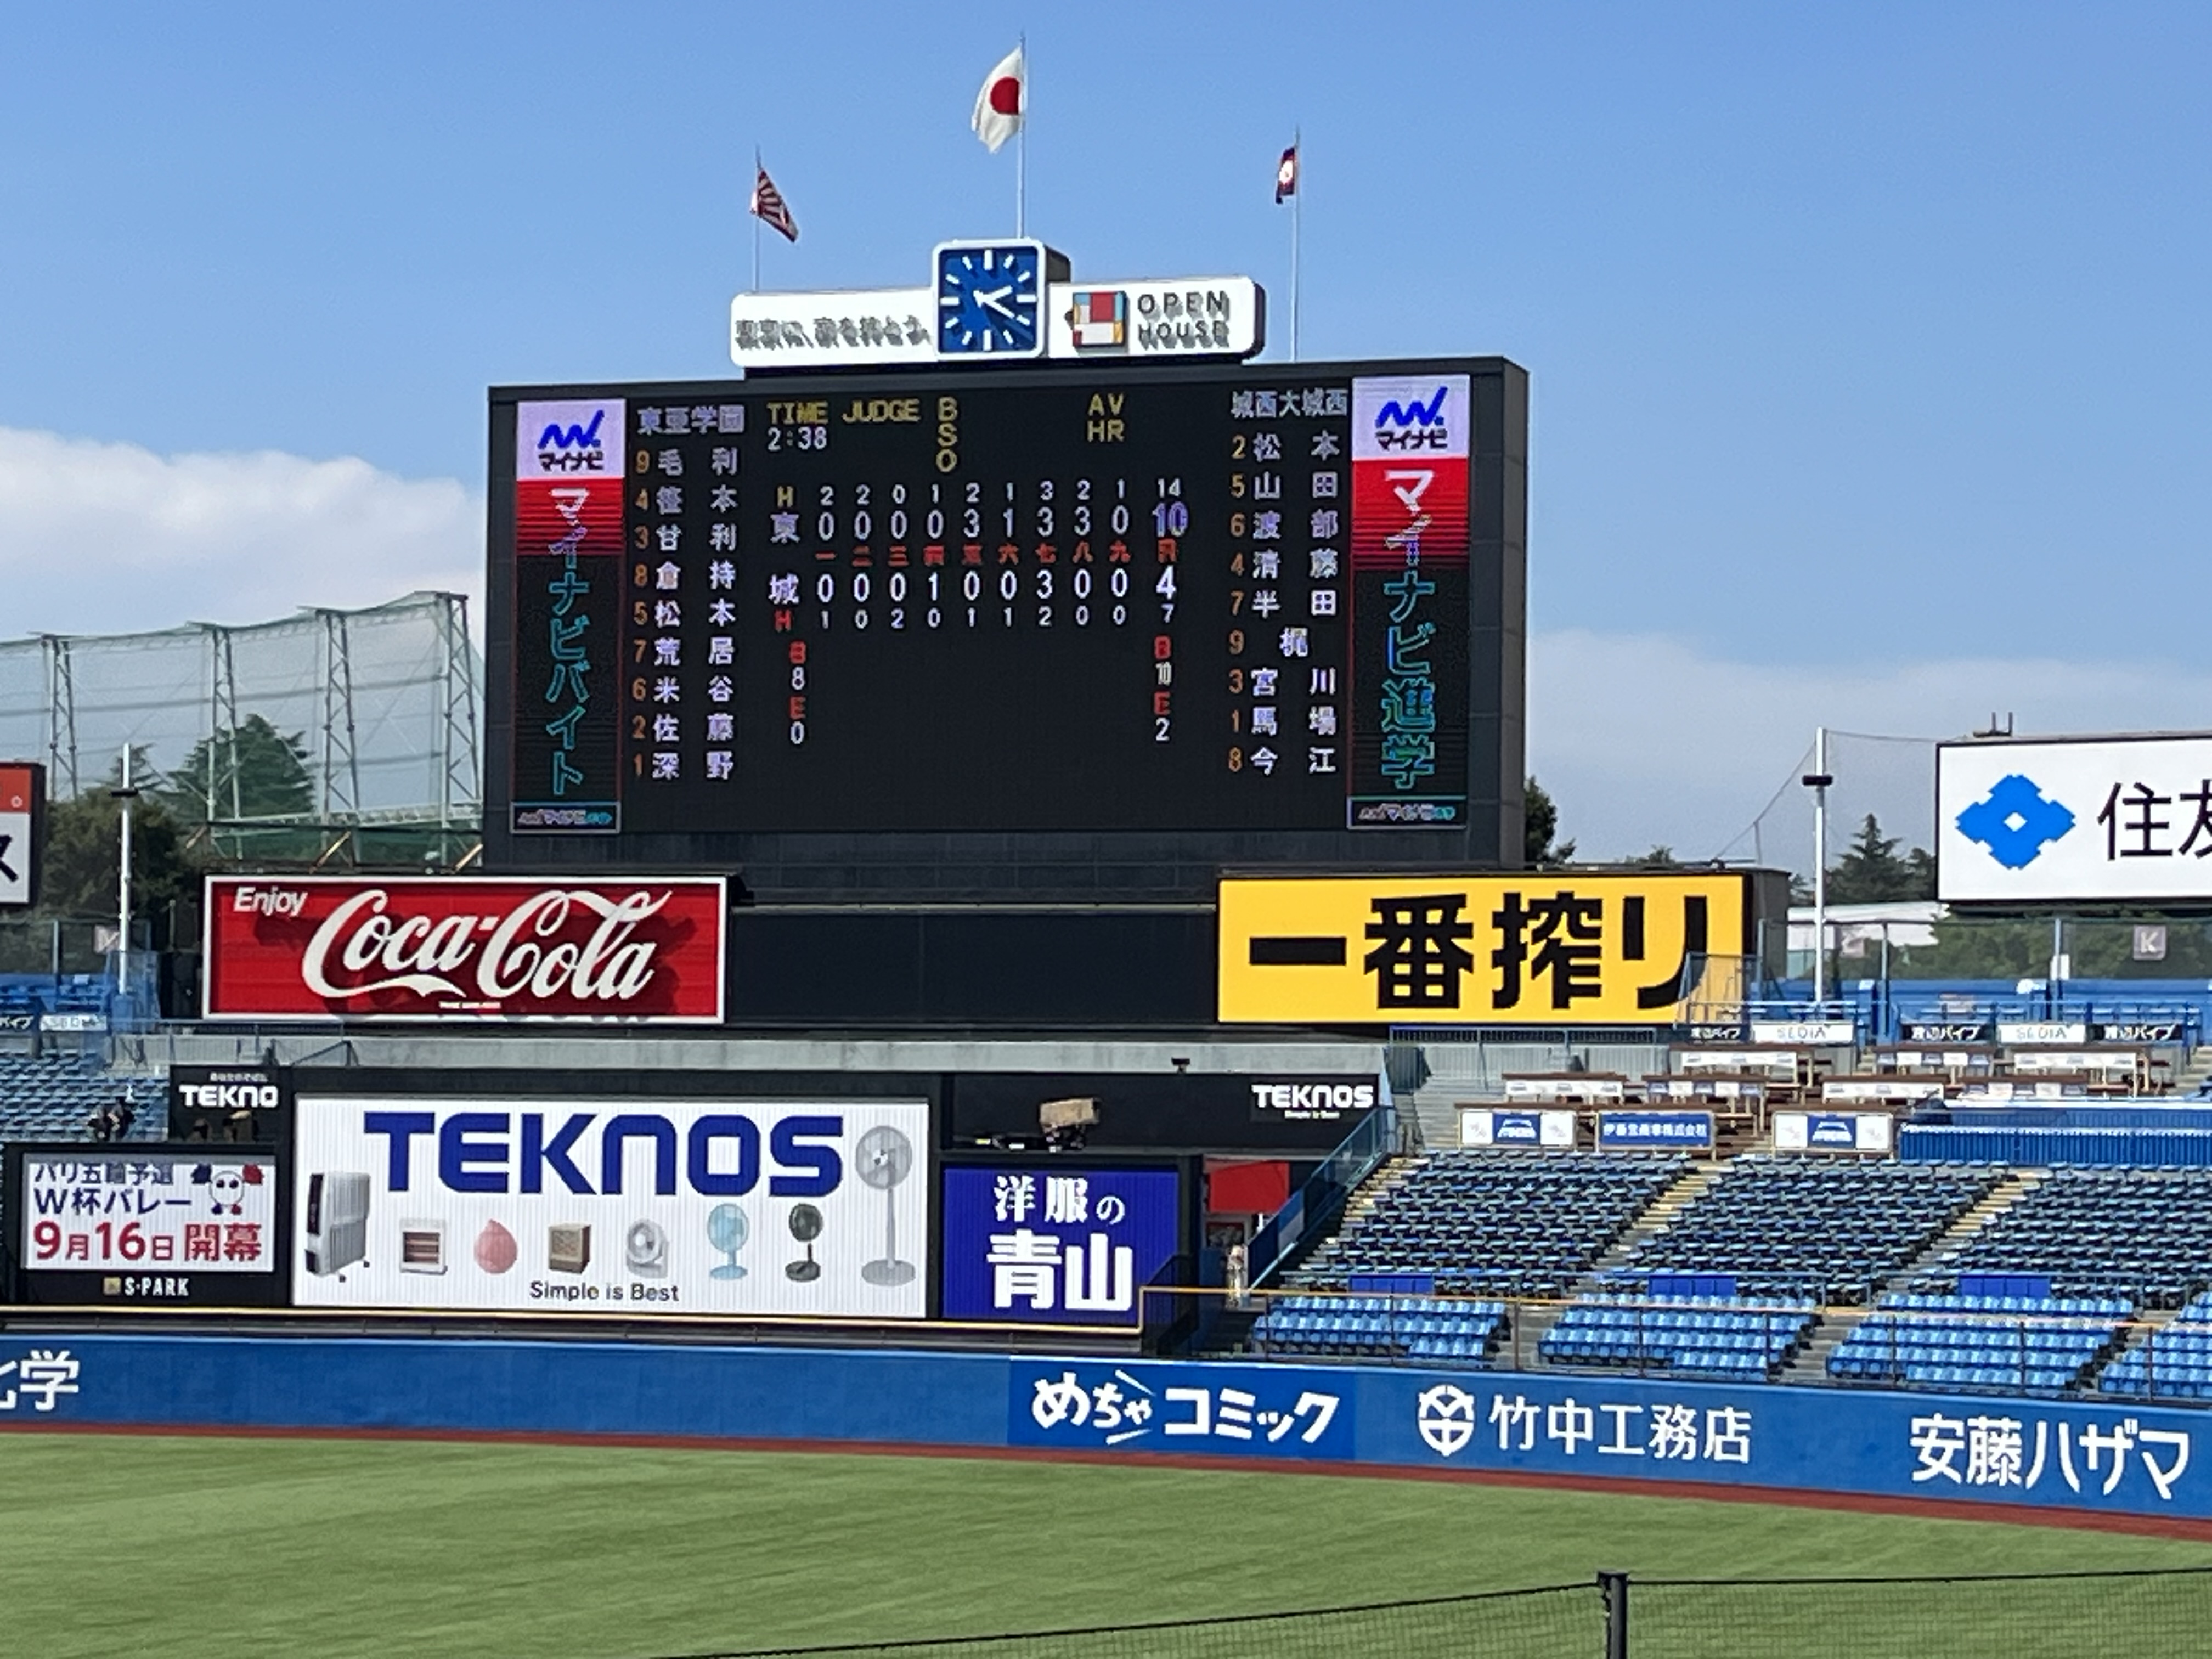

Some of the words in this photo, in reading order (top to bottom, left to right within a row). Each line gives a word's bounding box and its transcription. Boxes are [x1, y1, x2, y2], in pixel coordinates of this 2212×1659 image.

[1137, 291, 1230, 324] OPEN
[1137, 320, 1230, 351] HOUSE
[767, 401, 828, 425] TIME
[842, 398, 921, 423] JUDGE
[938, 397, 958, 422] B
[1088, 393, 1124, 416] AV
[1231, 387, 1348, 419] 城西大城西
[637, 404, 744, 436] 東亜学園
[1087, 419, 1124, 442] HR
[768, 426, 827, 451] 2:38
[938, 422, 957, 447] S
[1232, 435, 1245, 459] 2
[1375, 426, 1448, 451] マイナビ
[538, 450, 603, 472] マイナビ
[636, 450, 650, 473] 9
[777, 486, 793, 507] H
[820, 486, 833, 506] 2
[856, 484, 870, 505] 2
[892, 484, 906, 504] 0
[932, 484, 939, 503] 1
[966, 482, 980, 503] 2
[1007, 482, 1013, 501] 1
[1040, 480, 1053, 500] 3
[1077, 479, 1090, 500] 2
[1118, 479, 1124, 498] 1
[1158, 478, 1181, 498] 14
[1231, 475, 1245, 498] 5
[635, 489, 648, 510] 4
[770, 512, 800, 543] 東
[818, 512, 834, 541] 0
[854, 511, 871, 540] 0
[891, 510, 907, 539] 0
[927, 510, 944, 539] 0
[963, 508, 980, 538] 3
[1003, 508, 1013, 537] 1
[1037, 506, 1053, 537] 3
[1074, 506, 1090, 535] 3
[1112, 505, 1129, 534] 0
[1152, 501, 1188, 540] 10
[1231, 513, 1245, 537] 6
[635, 526, 649, 549] 3
[852, 546, 872, 567] 二
[888, 545, 909, 567] 三
[998, 543, 1019, 565] 六
[1035, 543, 1056, 563] 七
[1072, 541, 1093, 563] 八
[1109, 540, 1131, 562] 九
[1158, 538, 1177, 563] R
[1231, 552, 1244, 576] 4
[634, 564, 647, 586] 8
[768, 573, 799, 605] 城
[817, 574, 834, 603] 0
[854, 573, 870, 602] 0
[890, 572, 906, 601] 0
[928, 572, 938, 601] 1
[964, 570, 980, 601] 0
[1000, 570, 1017, 600] 0
[1036, 569, 1053, 599] 3
[1074, 568, 1091, 599] 0
[1111, 568, 1128, 597] 0
[1156, 565, 1177, 600] 4
[634, 601, 648, 625] 5
[1231, 591, 1244, 616] 7
[775, 610, 791, 631] H
[821, 611, 828, 629] 1
[855, 610, 868, 629] 0
[891, 608, 904, 629] 2
[928, 607, 940, 628] 0
[968, 607, 975, 627] 1
[1004, 607, 1012, 627] 1
[1039, 606, 1051, 626] 2
[1076, 605, 1088, 625] 0
[1113, 605, 1126, 625] 0
[1161, 603, 1174, 623] 7
[1381, 469, 1435, 789] マイナビ進学
[545, 487, 590, 795] マイナビバイト
[634, 639, 647, 662] 7
[789, 641, 806, 664] B
[1154, 635, 1171, 659] B
[1229, 630, 1244, 654] 9
[792, 667, 805, 690] 8
[1155, 661, 1172, 685] 10
[1229, 669, 1243, 693] 3
[632, 678, 646, 701] 6
[789, 696, 805, 720] E
[1154, 691, 1170, 715] E
[633, 715, 646, 739] 2
[791, 721, 804, 744] 0
[1155, 717, 1170, 741] 2
[1232, 709, 1239, 732] 1
[634, 754, 642, 776] 1
[1228, 747, 1242, 772] 8
[231, 886, 308, 917] Enjoy
[302, 890, 673, 1000] Coca-Cola
[1251, 1085, 1374, 1108] TEKNOS
[362, 1111, 844, 1198] TEKNOS
[33, 1187, 192, 1216] W杯バレー
[994, 1175, 1125, 1225] 洋服の
[33, 1220, 174, 1261] 9月16日
[184, 1223, 262, 1261] 開幕
[986, 1228, 1133, 1311] 青山
[530, 1280, 601, 1301] Simple
[606, 1282, 623, 1300] is
[630, 1283, 679, 1301] Best
[1031, 1370, 1339, 1445] めちゃコミック
[1489, 1395, 1752, 1464] 竹中工務店
[1910, 1414, 2190, 1500] 安藤ハザマ
